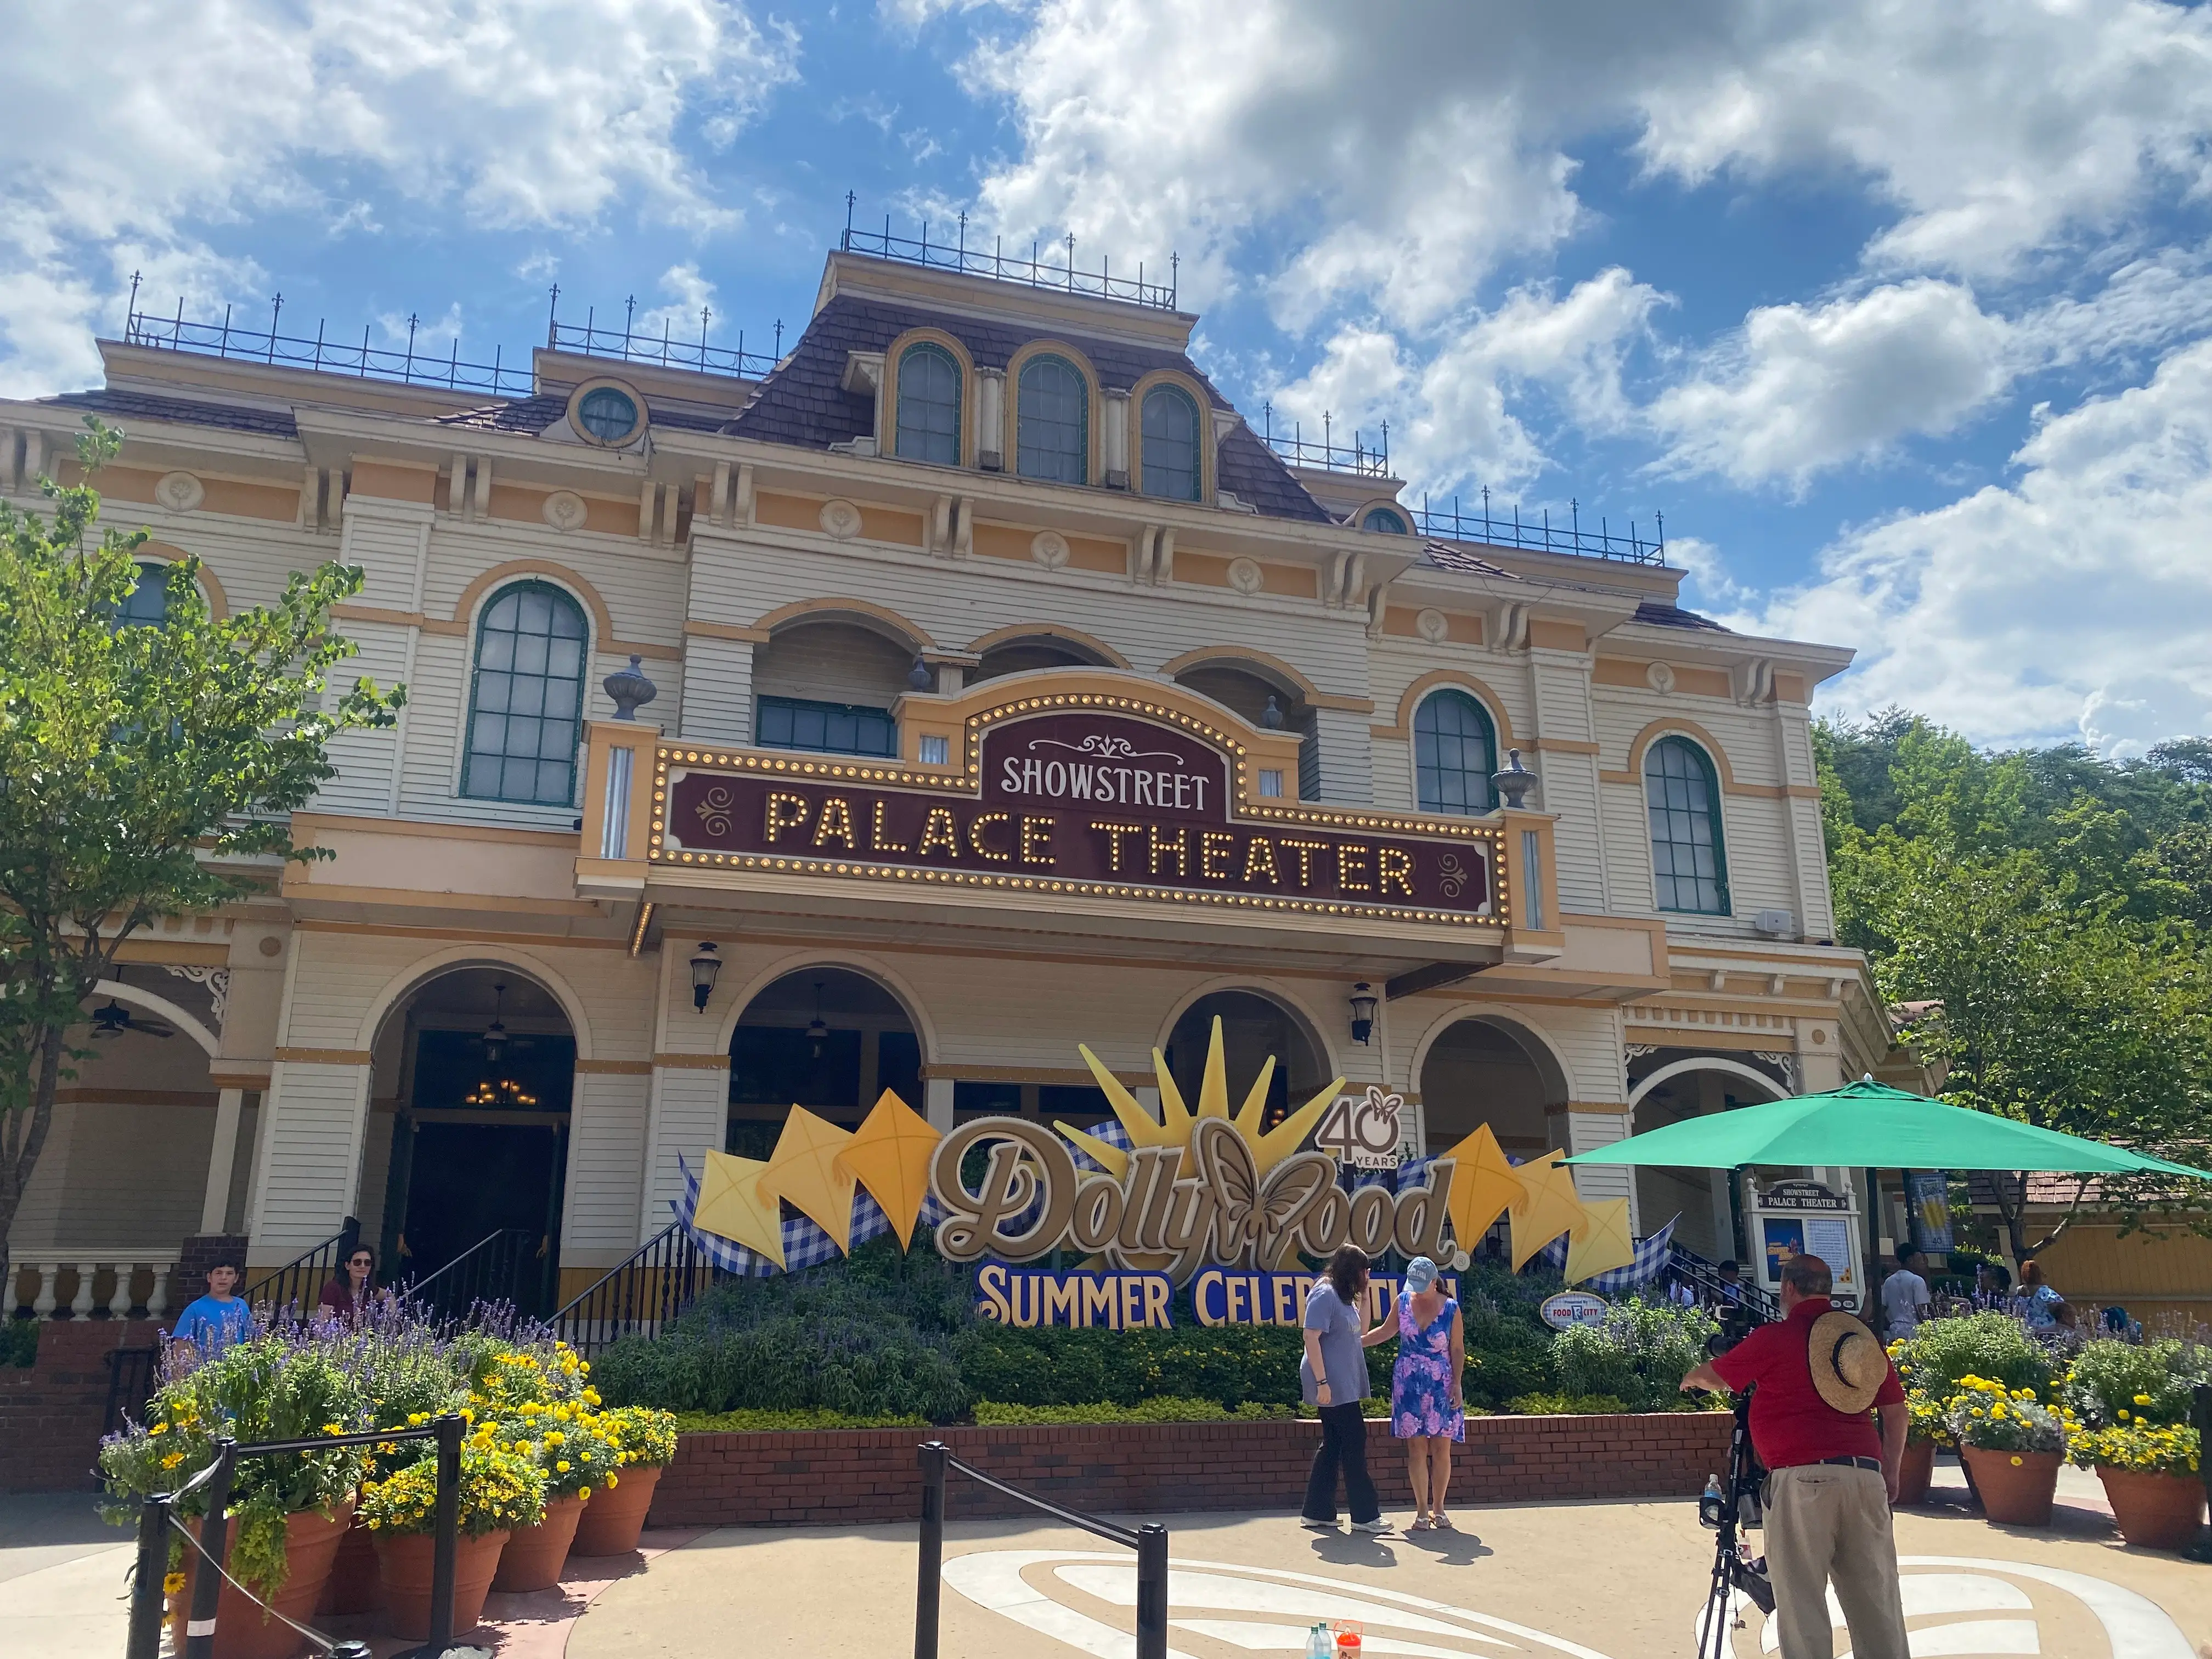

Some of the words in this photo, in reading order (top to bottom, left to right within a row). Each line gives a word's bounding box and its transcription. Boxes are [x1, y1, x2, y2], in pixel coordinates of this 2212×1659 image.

[1000, 756, 1210, 811] SHOWSTREET
[762, 789, 1057, 865] PALACE
[1089, 818, 1419, 896] THEATER
[1318, 1101, 1399, 1161] 40
[1356, 1156, 1397, 1167] YEARS
[1768, 1197, 1797, 1207] PALACE
[1801, 1198, 1837, 1208] THEATER
[1782, 1188, 1820, 1197] SHOWSTREET
[977, 1265, 1172, 1330] SUMMER
[1553, 1308, 1572, 1317] FOOD
[1583, 1308, 1598, 1317] CITY
